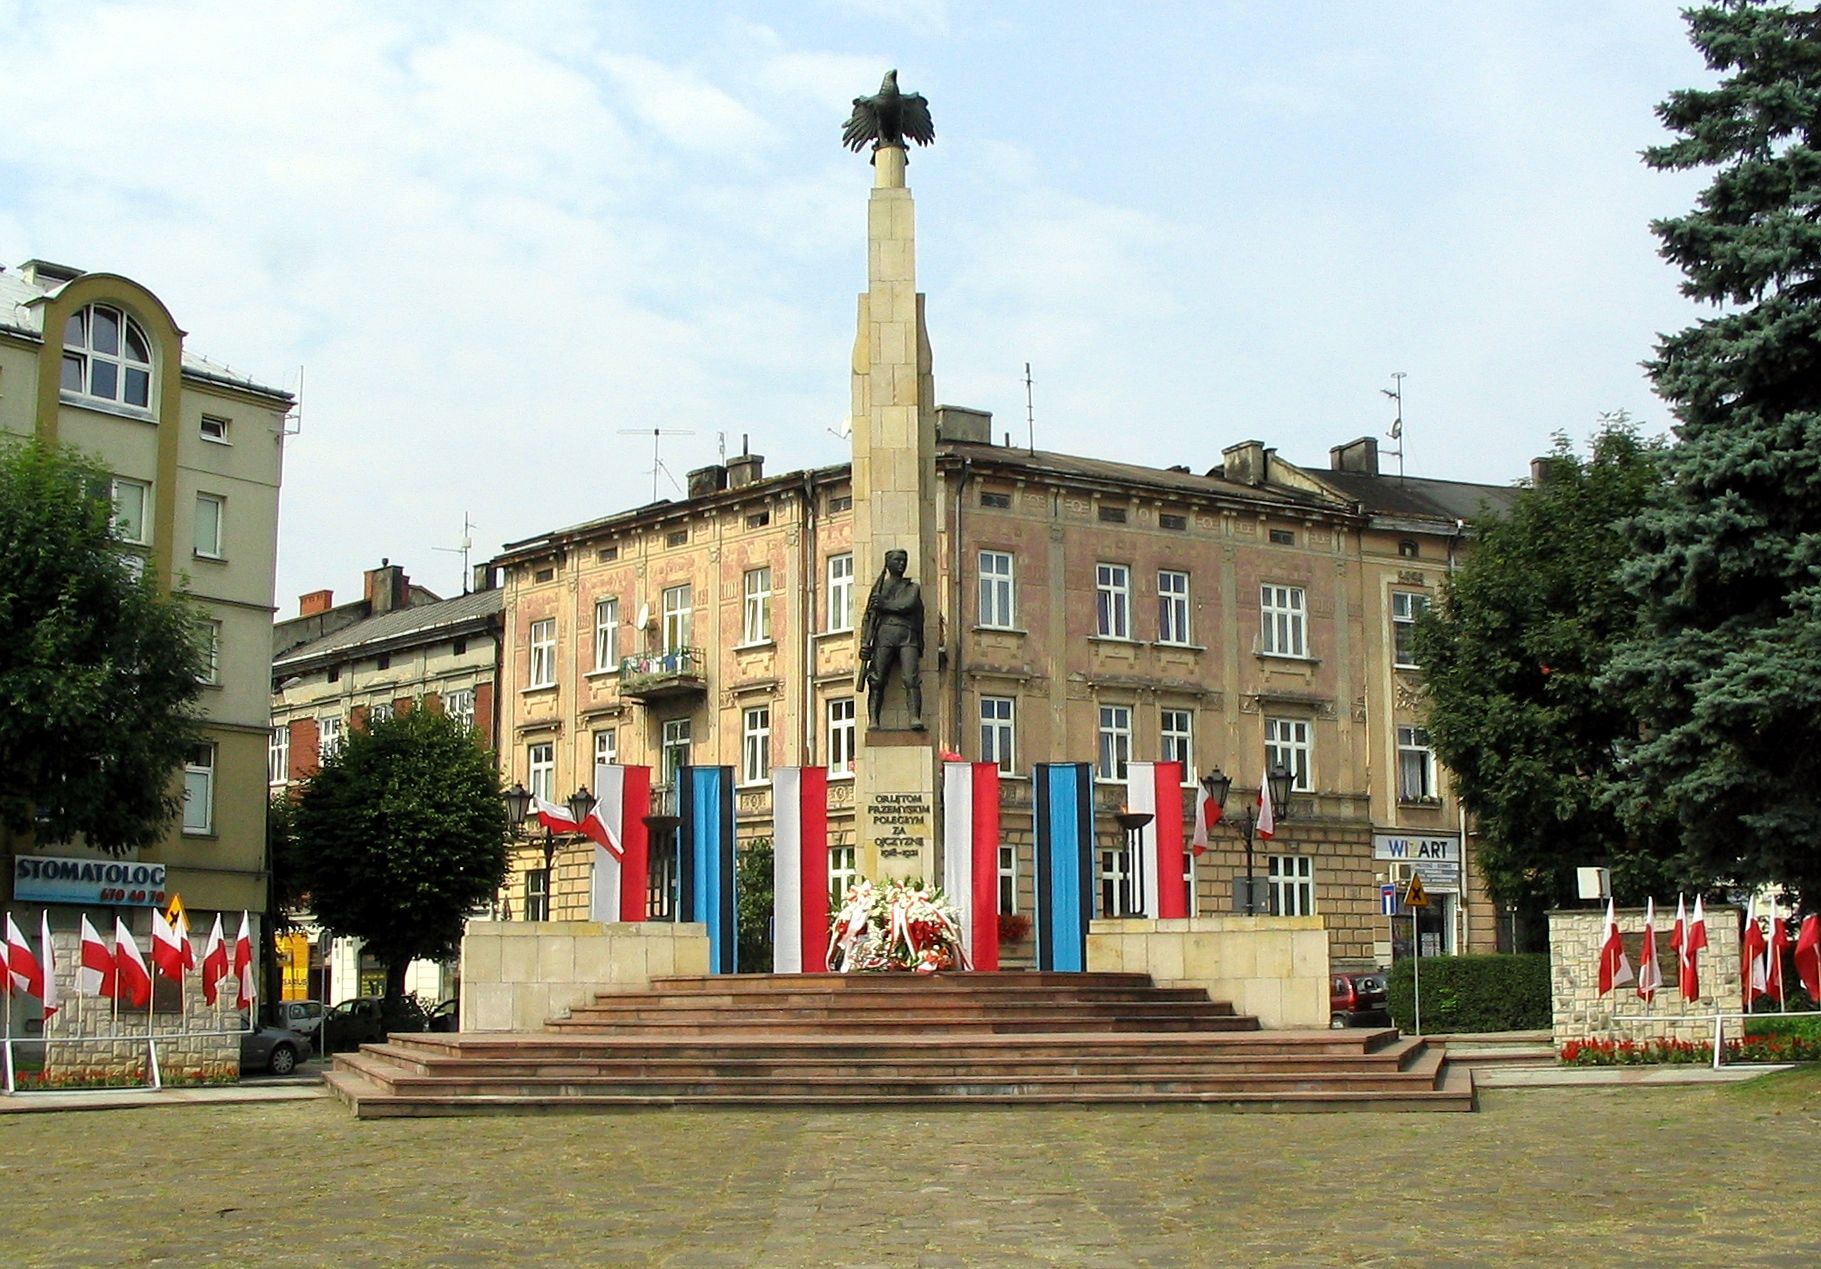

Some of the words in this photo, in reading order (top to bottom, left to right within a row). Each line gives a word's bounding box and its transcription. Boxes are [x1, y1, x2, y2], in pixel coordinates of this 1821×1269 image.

[868, 805, 930, 814] PRZEMYSKIM
[873, 816, 924, 825] POLEGŁYM
[892, 826, 907, 835] ZA
[1388, 839, 1448, 859] WIZART
[17, 858, 165, 886] STOMATOLOG
